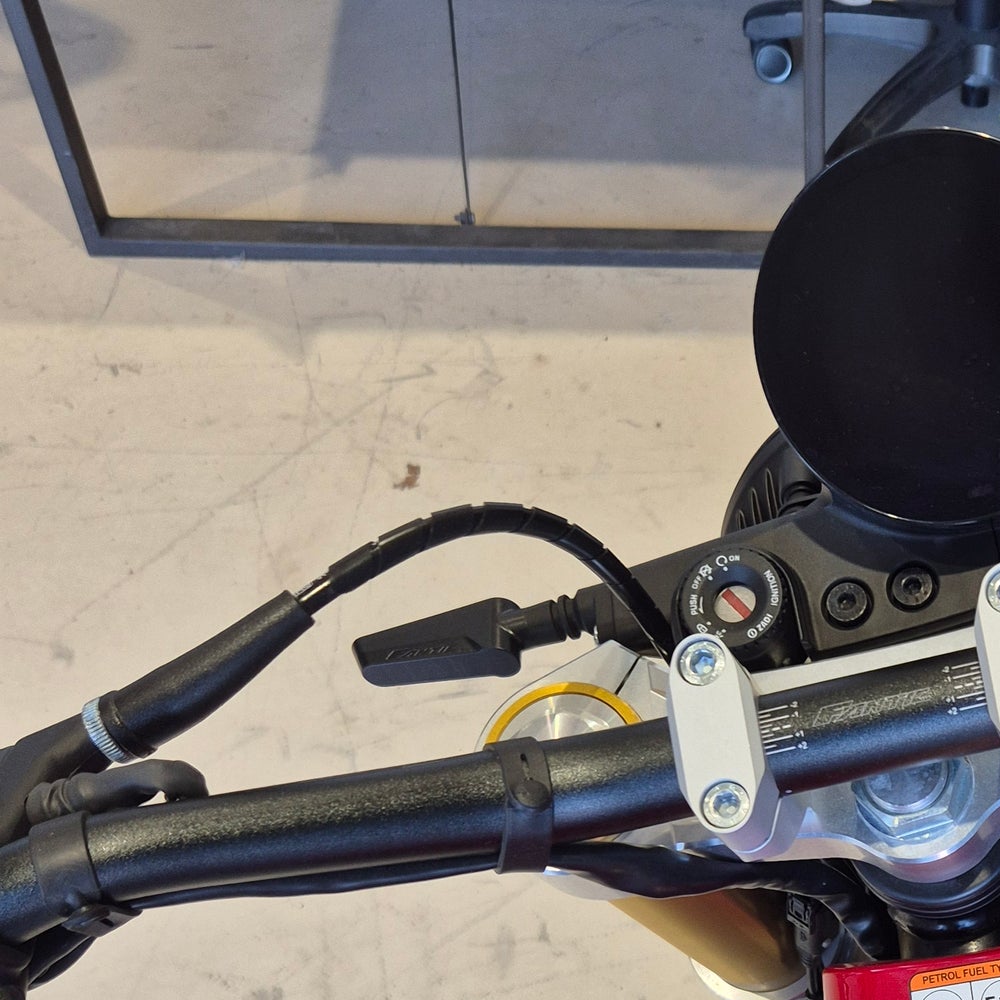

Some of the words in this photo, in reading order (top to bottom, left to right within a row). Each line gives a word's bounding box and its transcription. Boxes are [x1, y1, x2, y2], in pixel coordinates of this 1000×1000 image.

[691, 575, 703, 590] OFF
[763, 570, 780, 606] IGNITION
[689, 594, 699, 616] PUSH
[756, 613, 774, 632] ZADI
[922, 971, 961, 985] PETROL
[963, 966, 988, 978] FUEL
